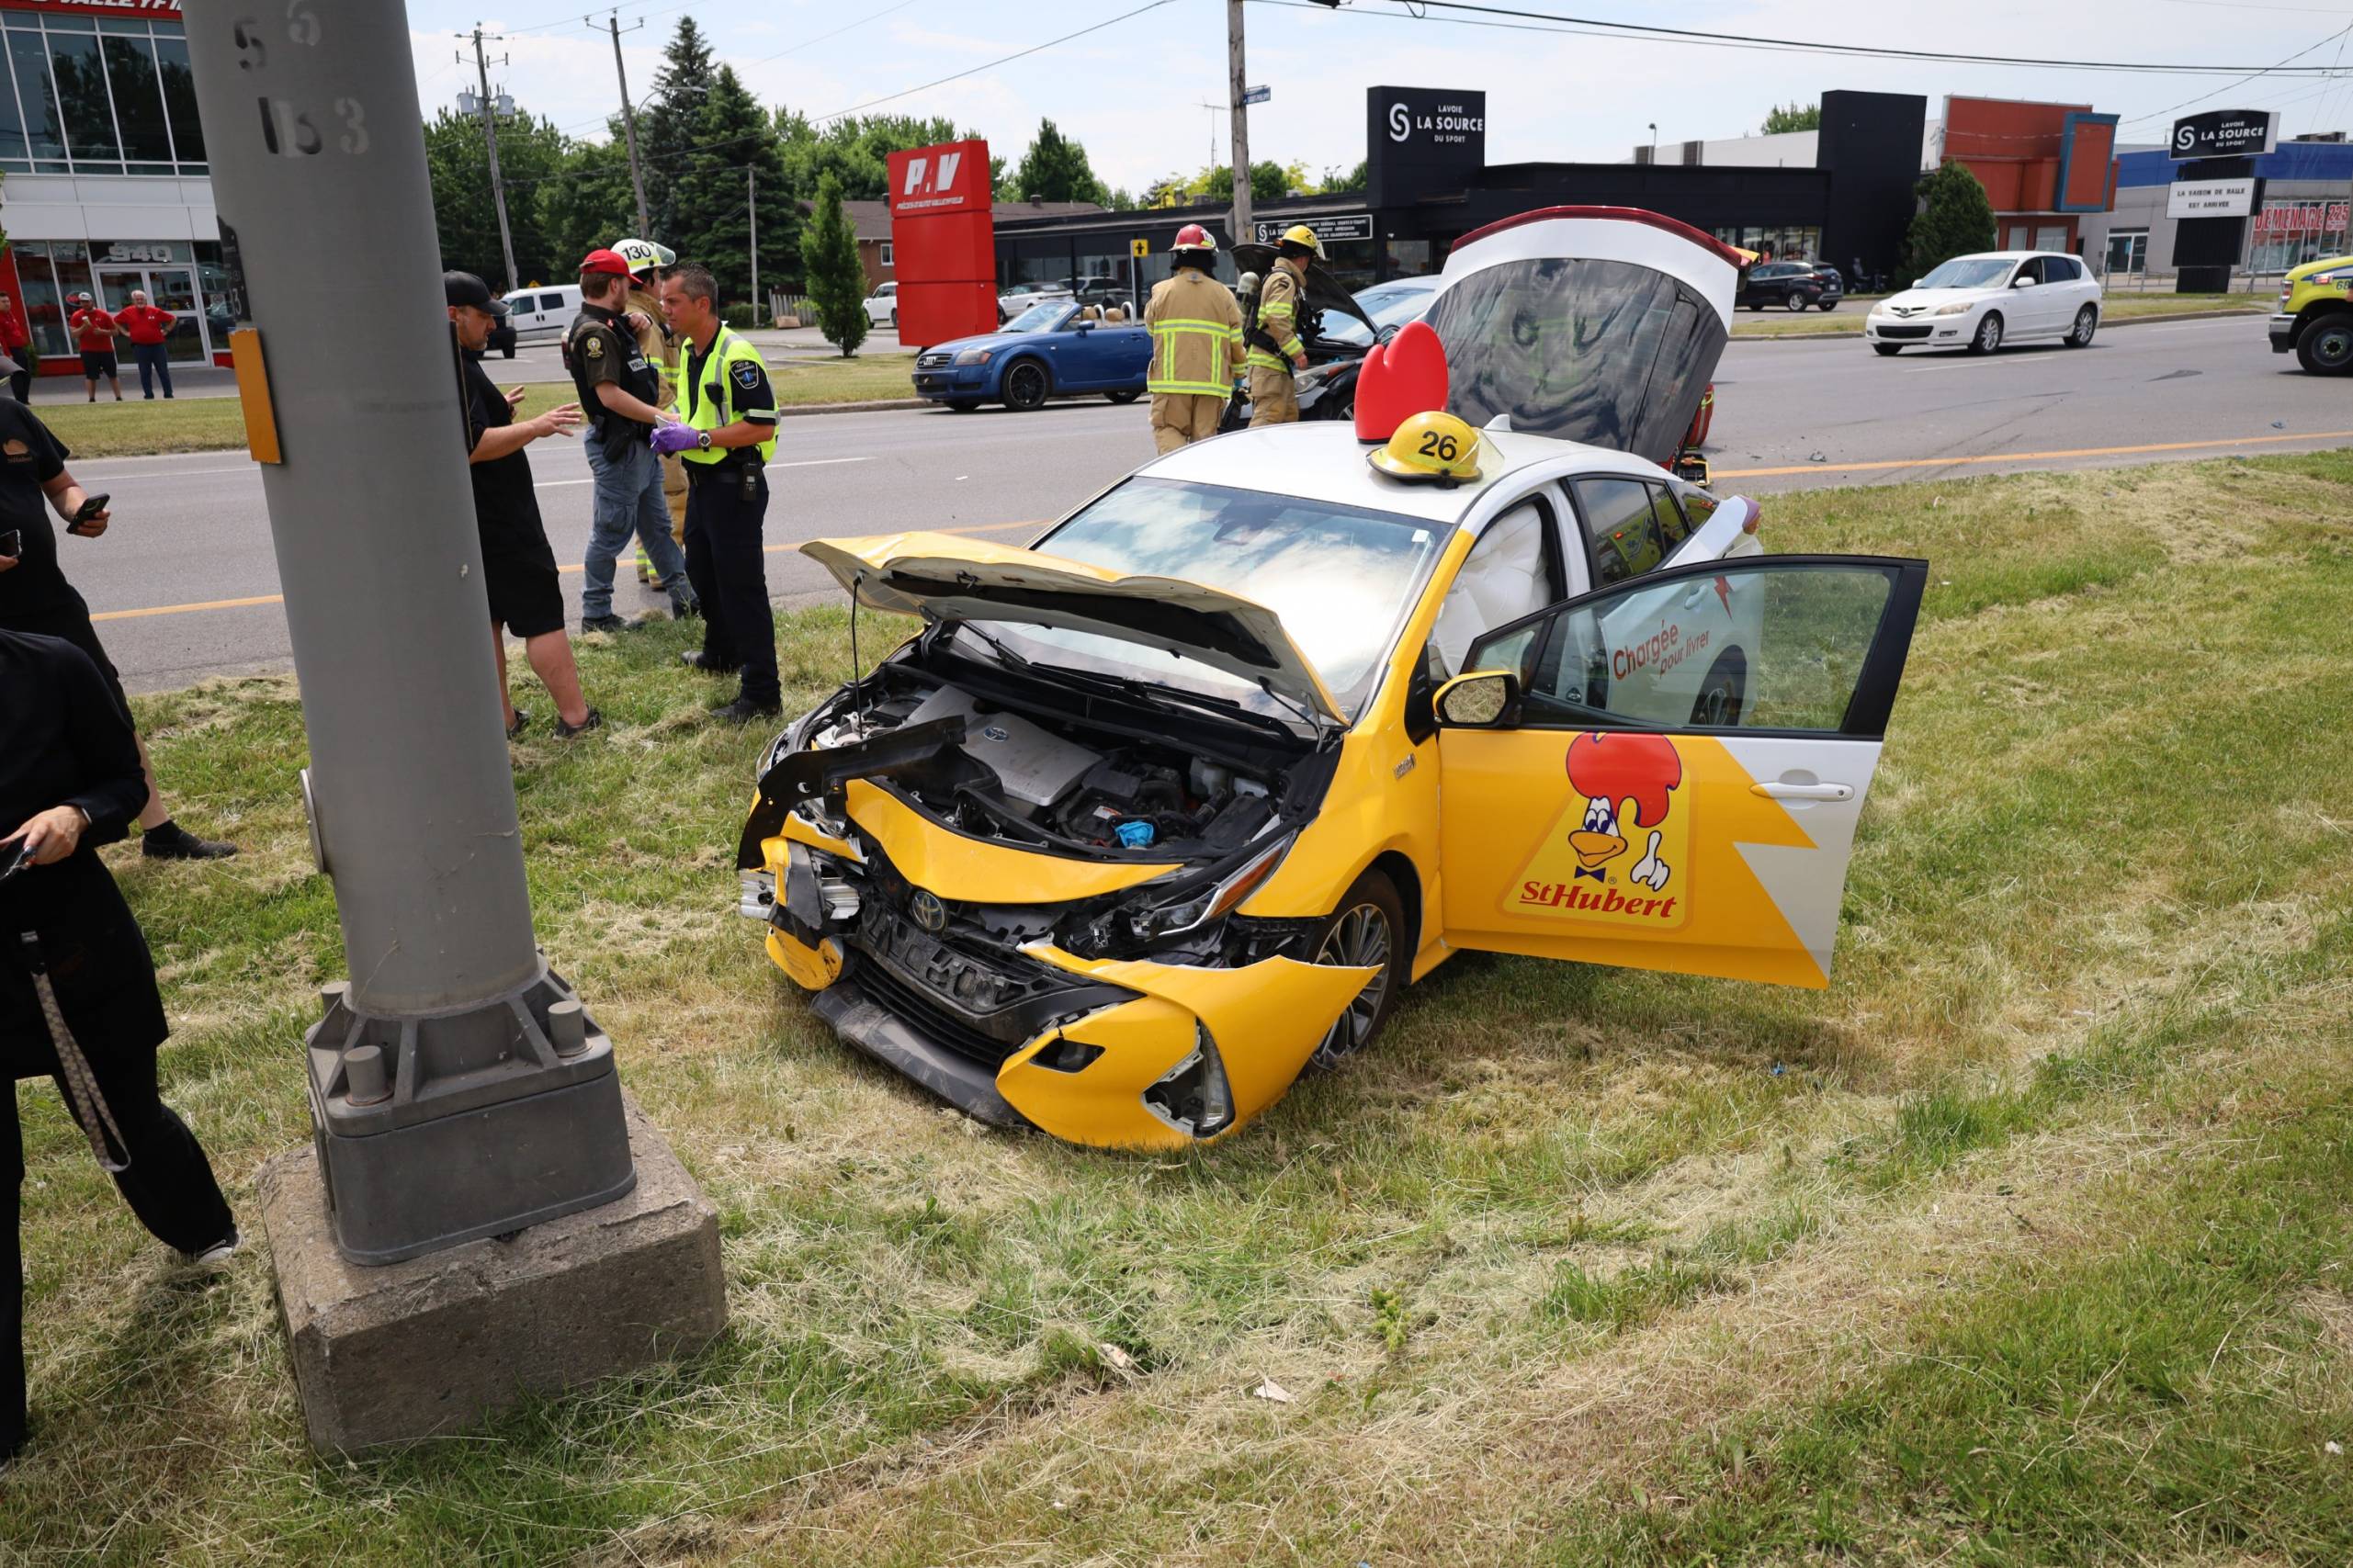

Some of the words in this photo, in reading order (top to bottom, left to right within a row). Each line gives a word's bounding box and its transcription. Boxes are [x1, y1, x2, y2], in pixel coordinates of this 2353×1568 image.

[1438, 105, 1463, 113] LAVOIE
[1417, 116, 1432, 130] LA
[1436, 117, 1484, 131] SOURCE
[1445, 135, 1465, 143] SPORT
[2200, 131, 2215, 141] LA
[2218, 127, 2265, 140] SOURCE
[623, 243, 651, 261] 130
[1418, 430, 1458, 461] 26
[1613, 619, 1679, 680] Chargée
[1659, 647, 1683, 679] pour
[1685, 631, 1709, 658] livrer
